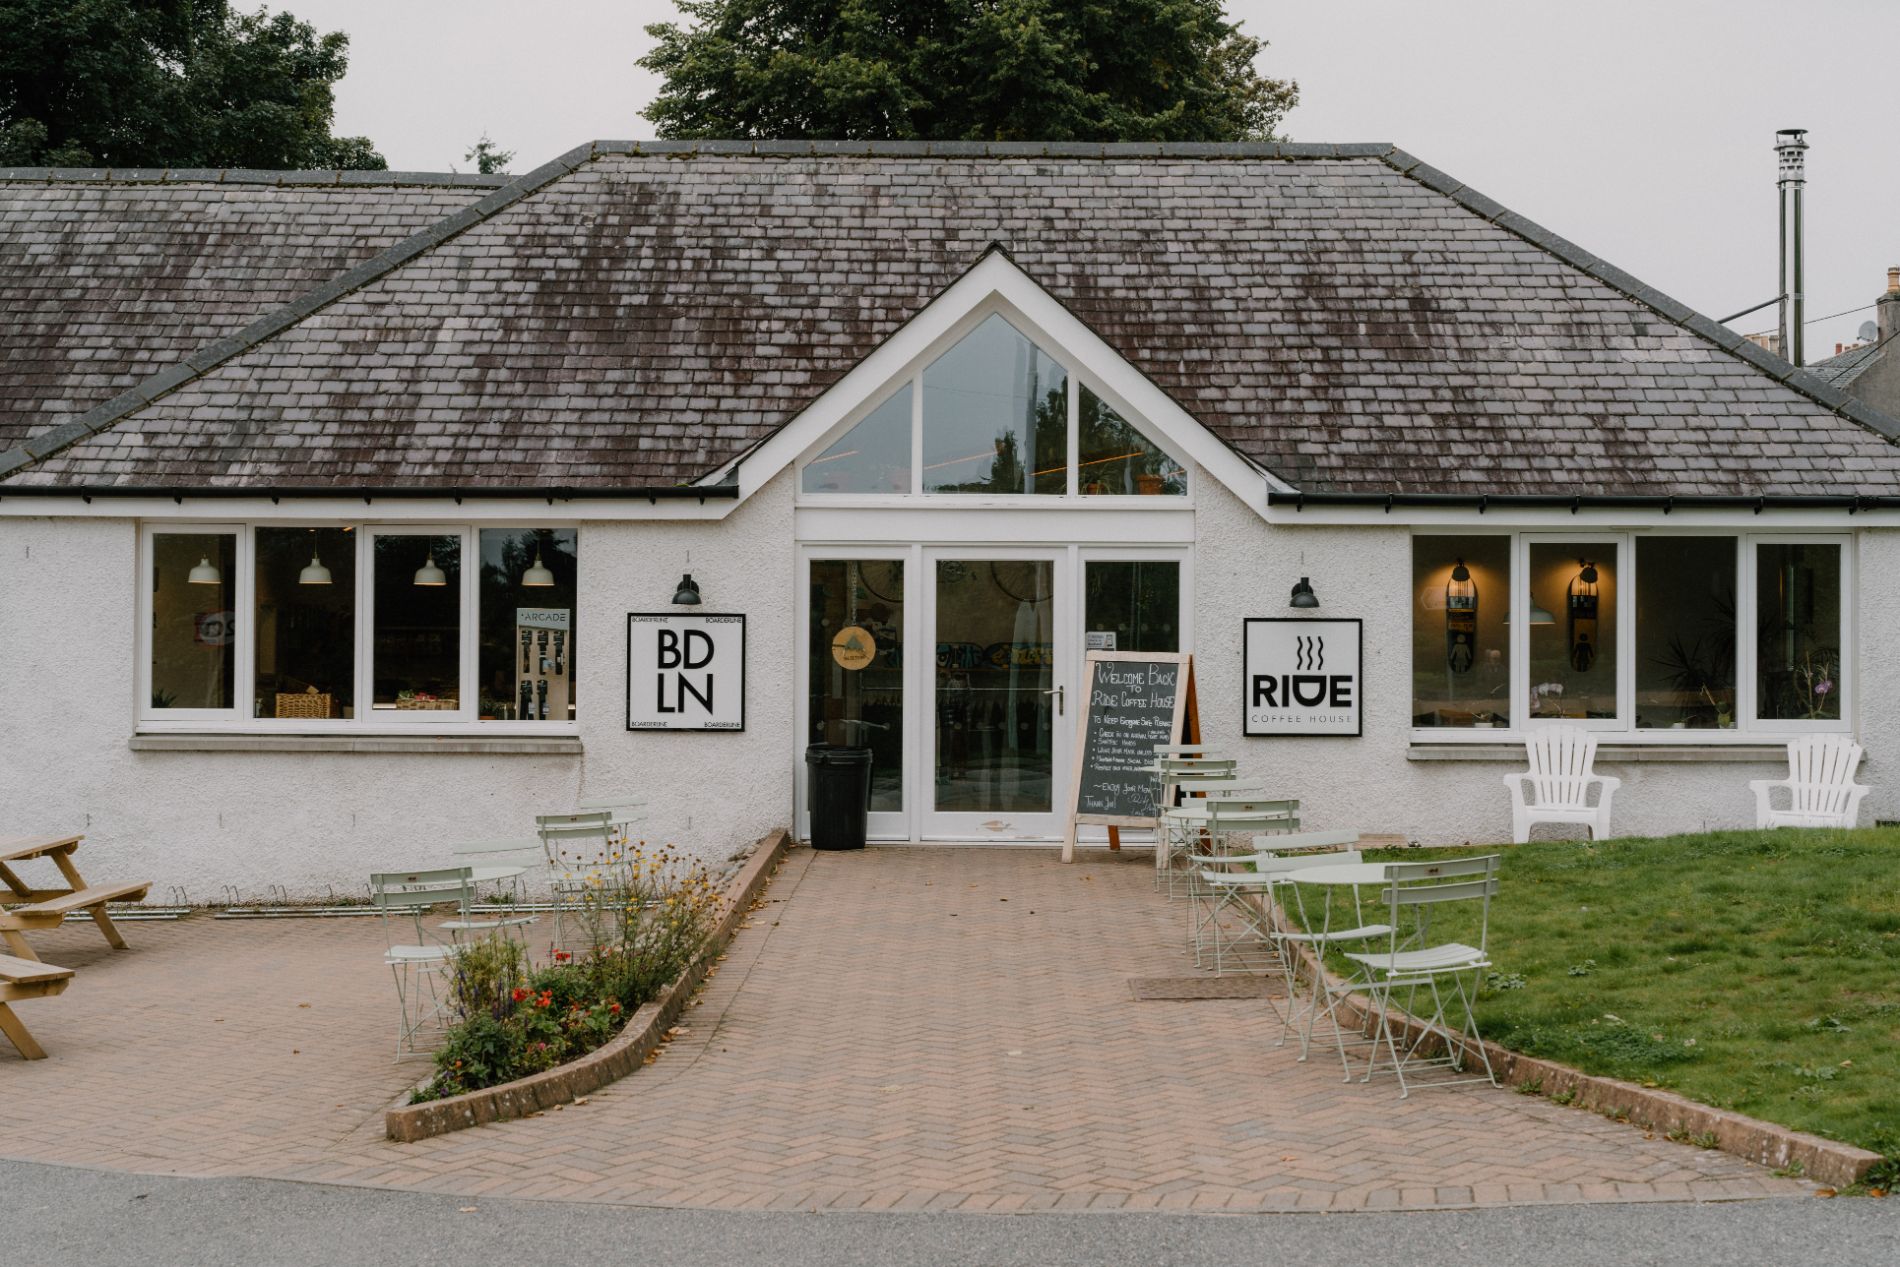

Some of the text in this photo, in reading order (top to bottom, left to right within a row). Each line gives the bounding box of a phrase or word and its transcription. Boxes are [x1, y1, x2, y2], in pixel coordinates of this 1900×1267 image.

[657, 629, 715, 669] BD
[1095, 662, 1176, 686] WELCOME BACK
[657, 671, 714, 716] LN
[1121, 691, 1147, 708] COFFEE
[1149, 692, 1175, 708] HOUSE
[1252, 674, 1353, 707] RIDE
[1251, 714, 1353, 723] COFFEE HOUSE
